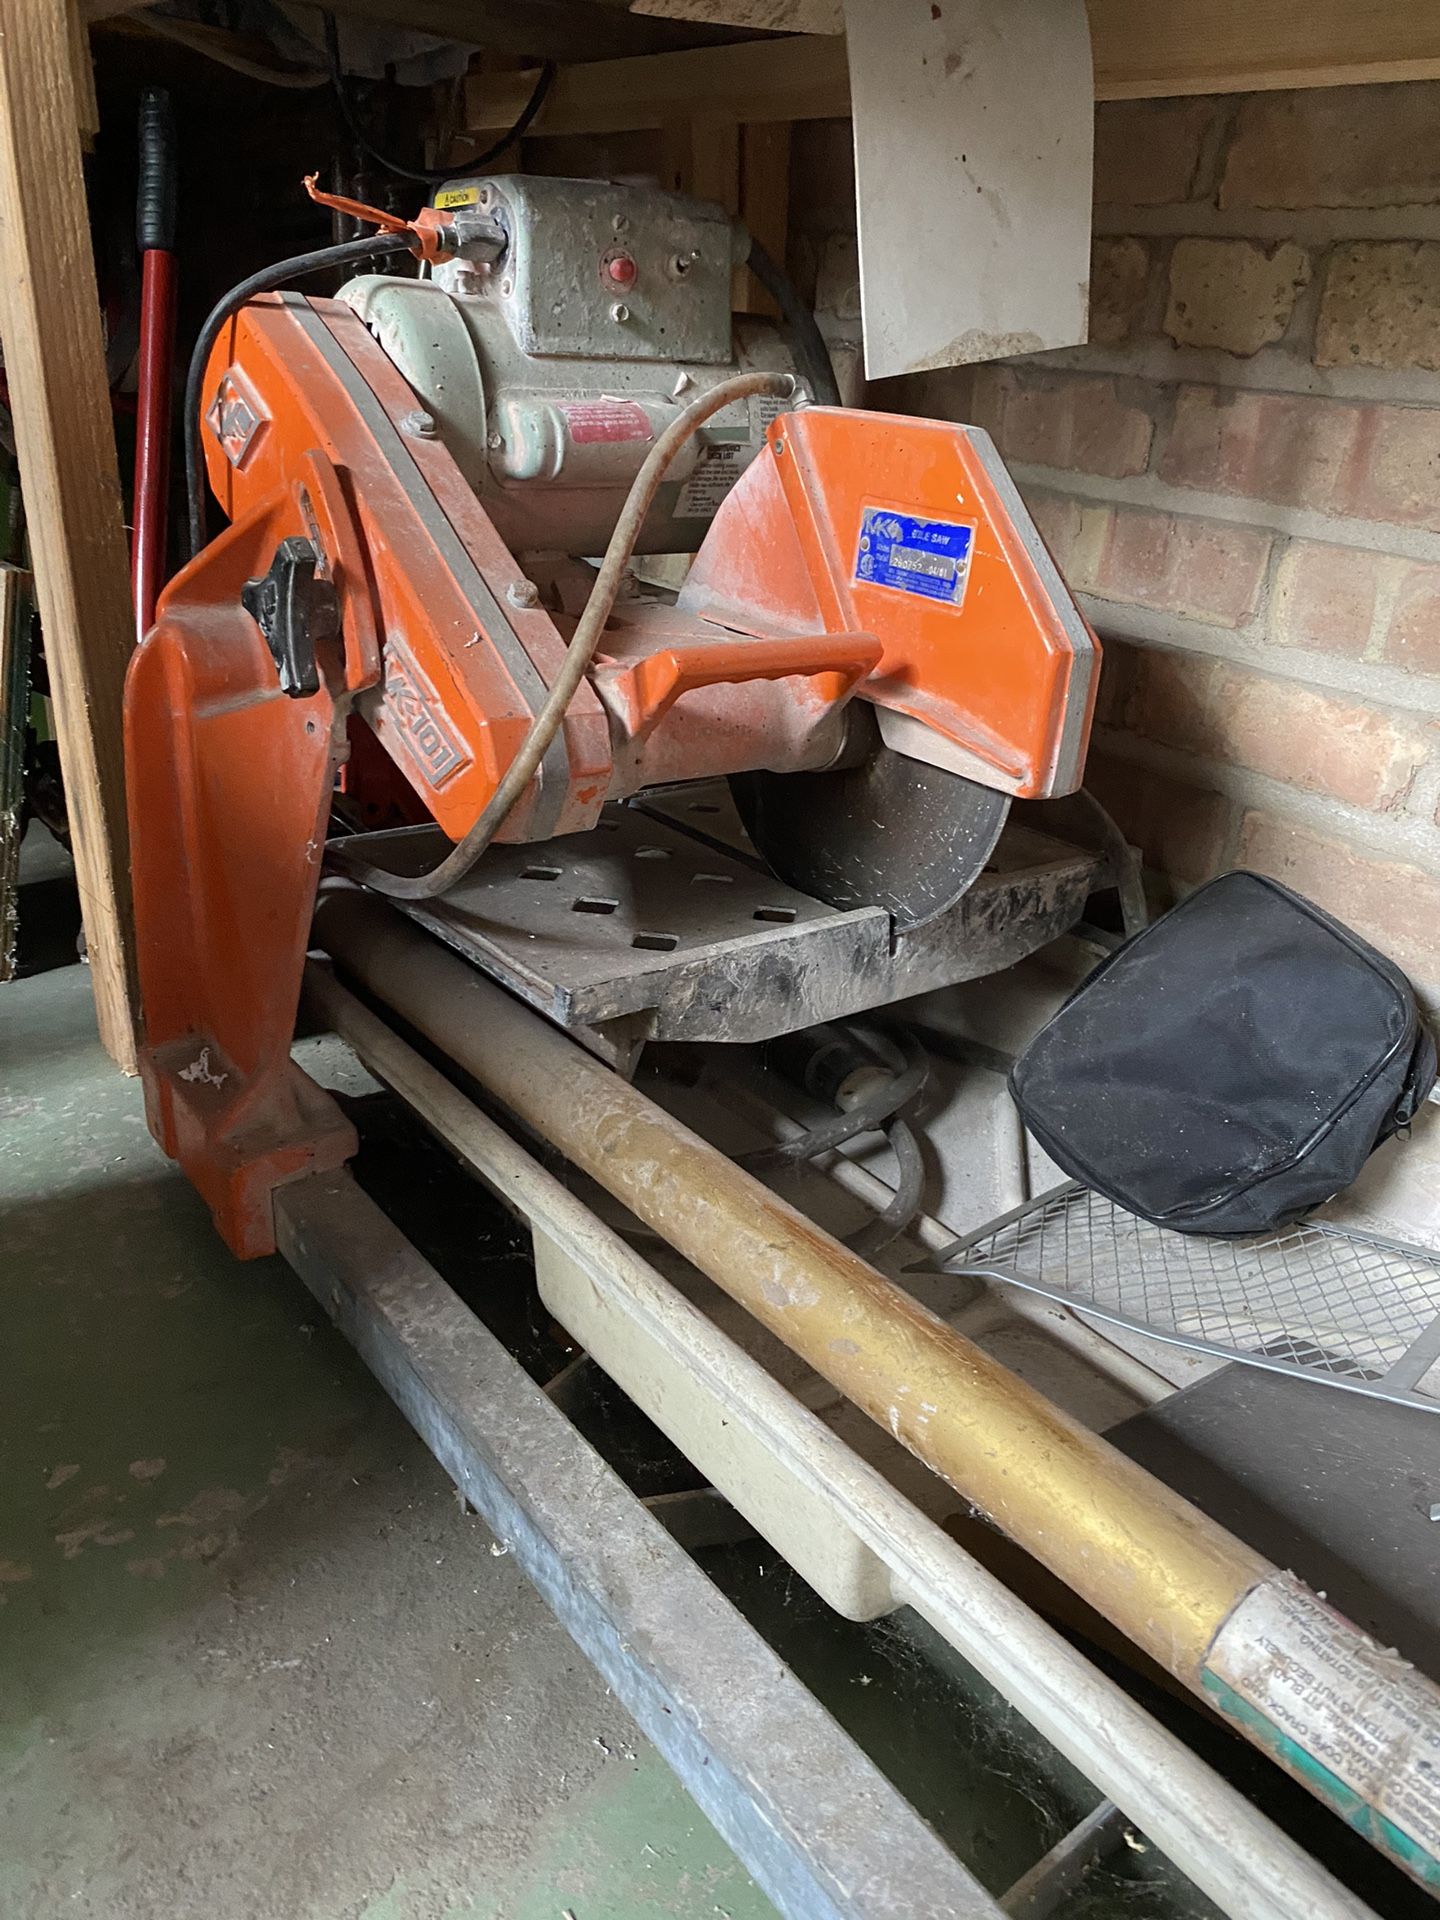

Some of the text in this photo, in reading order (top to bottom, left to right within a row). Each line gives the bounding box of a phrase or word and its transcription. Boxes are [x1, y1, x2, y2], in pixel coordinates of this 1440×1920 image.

[931, 533, 951, 545] SAW
[1301, 1690, 1323, 1711] FIT
[1311, 1679, 1340, 1706] NUT
[1380, 1697, 1422, 1733] WHILE
[1403, 1772, 1440, 1807] PECT
